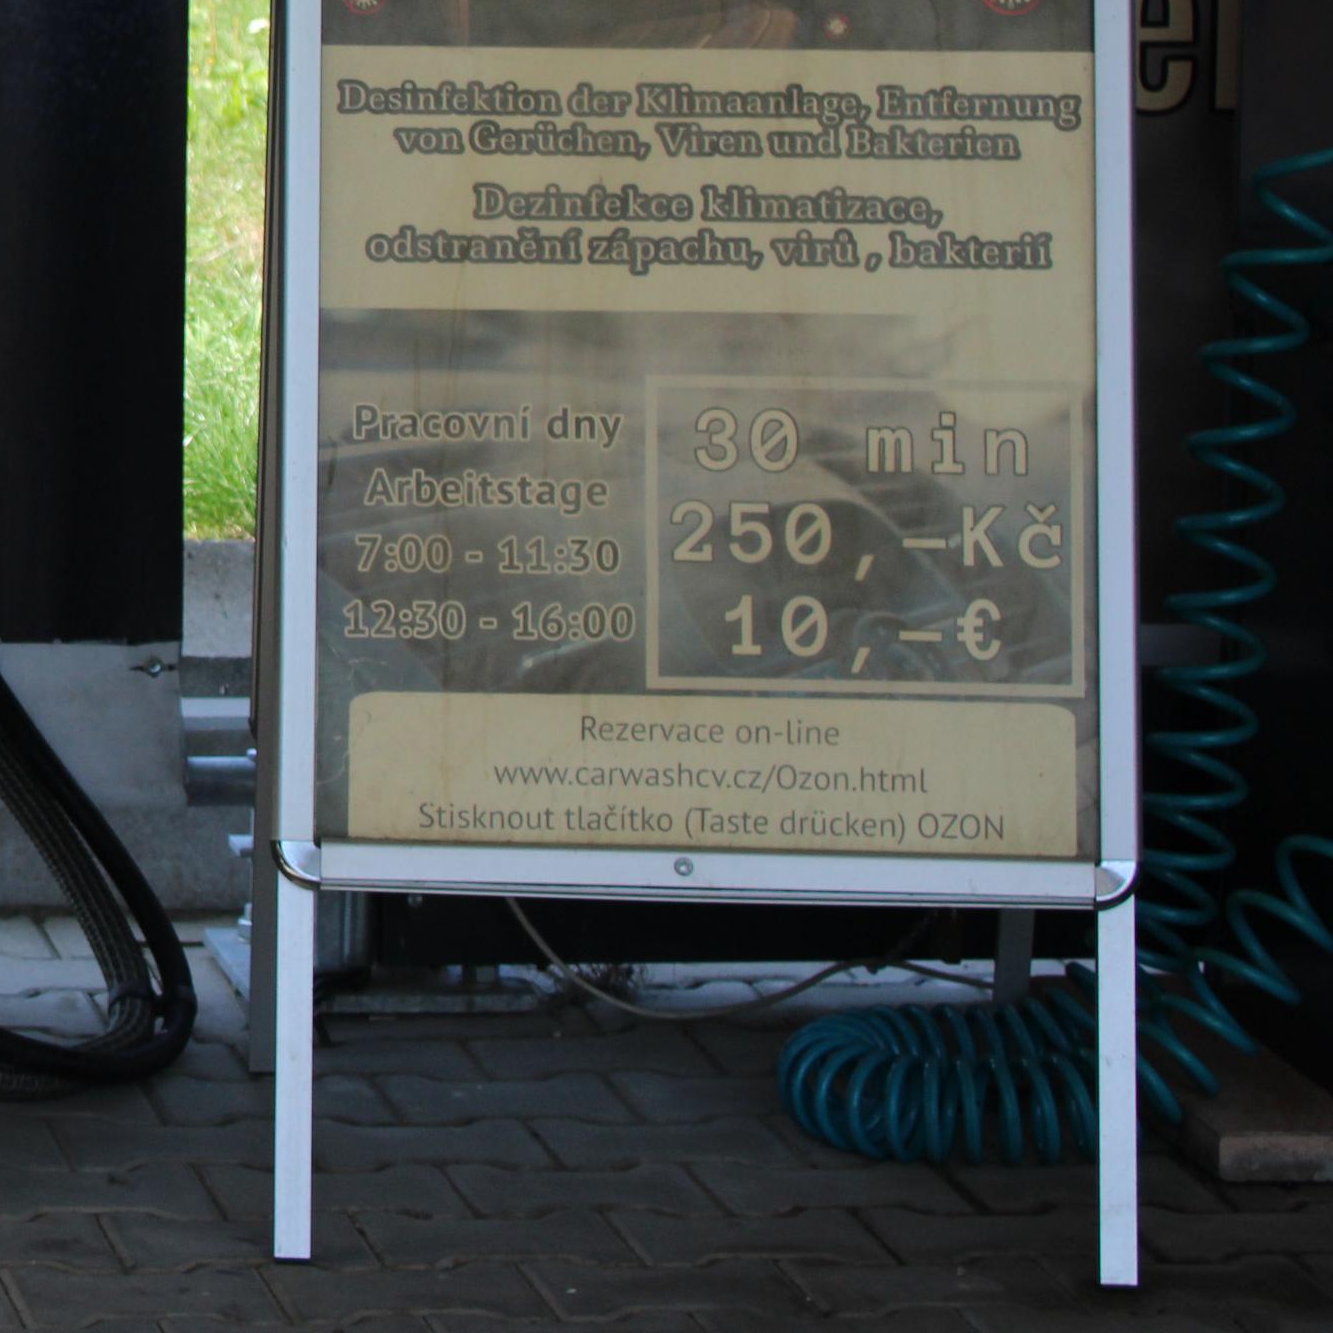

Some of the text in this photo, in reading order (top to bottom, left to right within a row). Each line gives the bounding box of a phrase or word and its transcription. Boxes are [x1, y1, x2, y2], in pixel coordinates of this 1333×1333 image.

[337, 81, 1083, 131] Desinfektion der Klimaanlage, Entfernung
[394, 121, 1021, 161] von Gerüchen, Viren und Bakterien
[473, 183, 945, 227] Dezinfekce klimatizace,
[364, 227, 583, 265] odstranění
[588, 231, 764, 274] zápachu,
[888, 229, 1054, 271] bakterií
[350, 403, 623, 449] Pracovní dny
[693, 407, 1030, 476] 30 min
[363, 468, 612, 514] Arbeitstage
[354, 531, 452, 573] 7:00
[496, 533, 622, 575] 11:30
[342, 598, 467, 641] 12:30
[511, 599, 637, 642] 16:00
[581, 714, 839, 746] Rezervace on-line
[493, 762, 928, 793] www.carwashcv.cz/Ozon.html
[418, 802, 1004, 846] Stisknout tlačítko (Taste drücken) OZON
